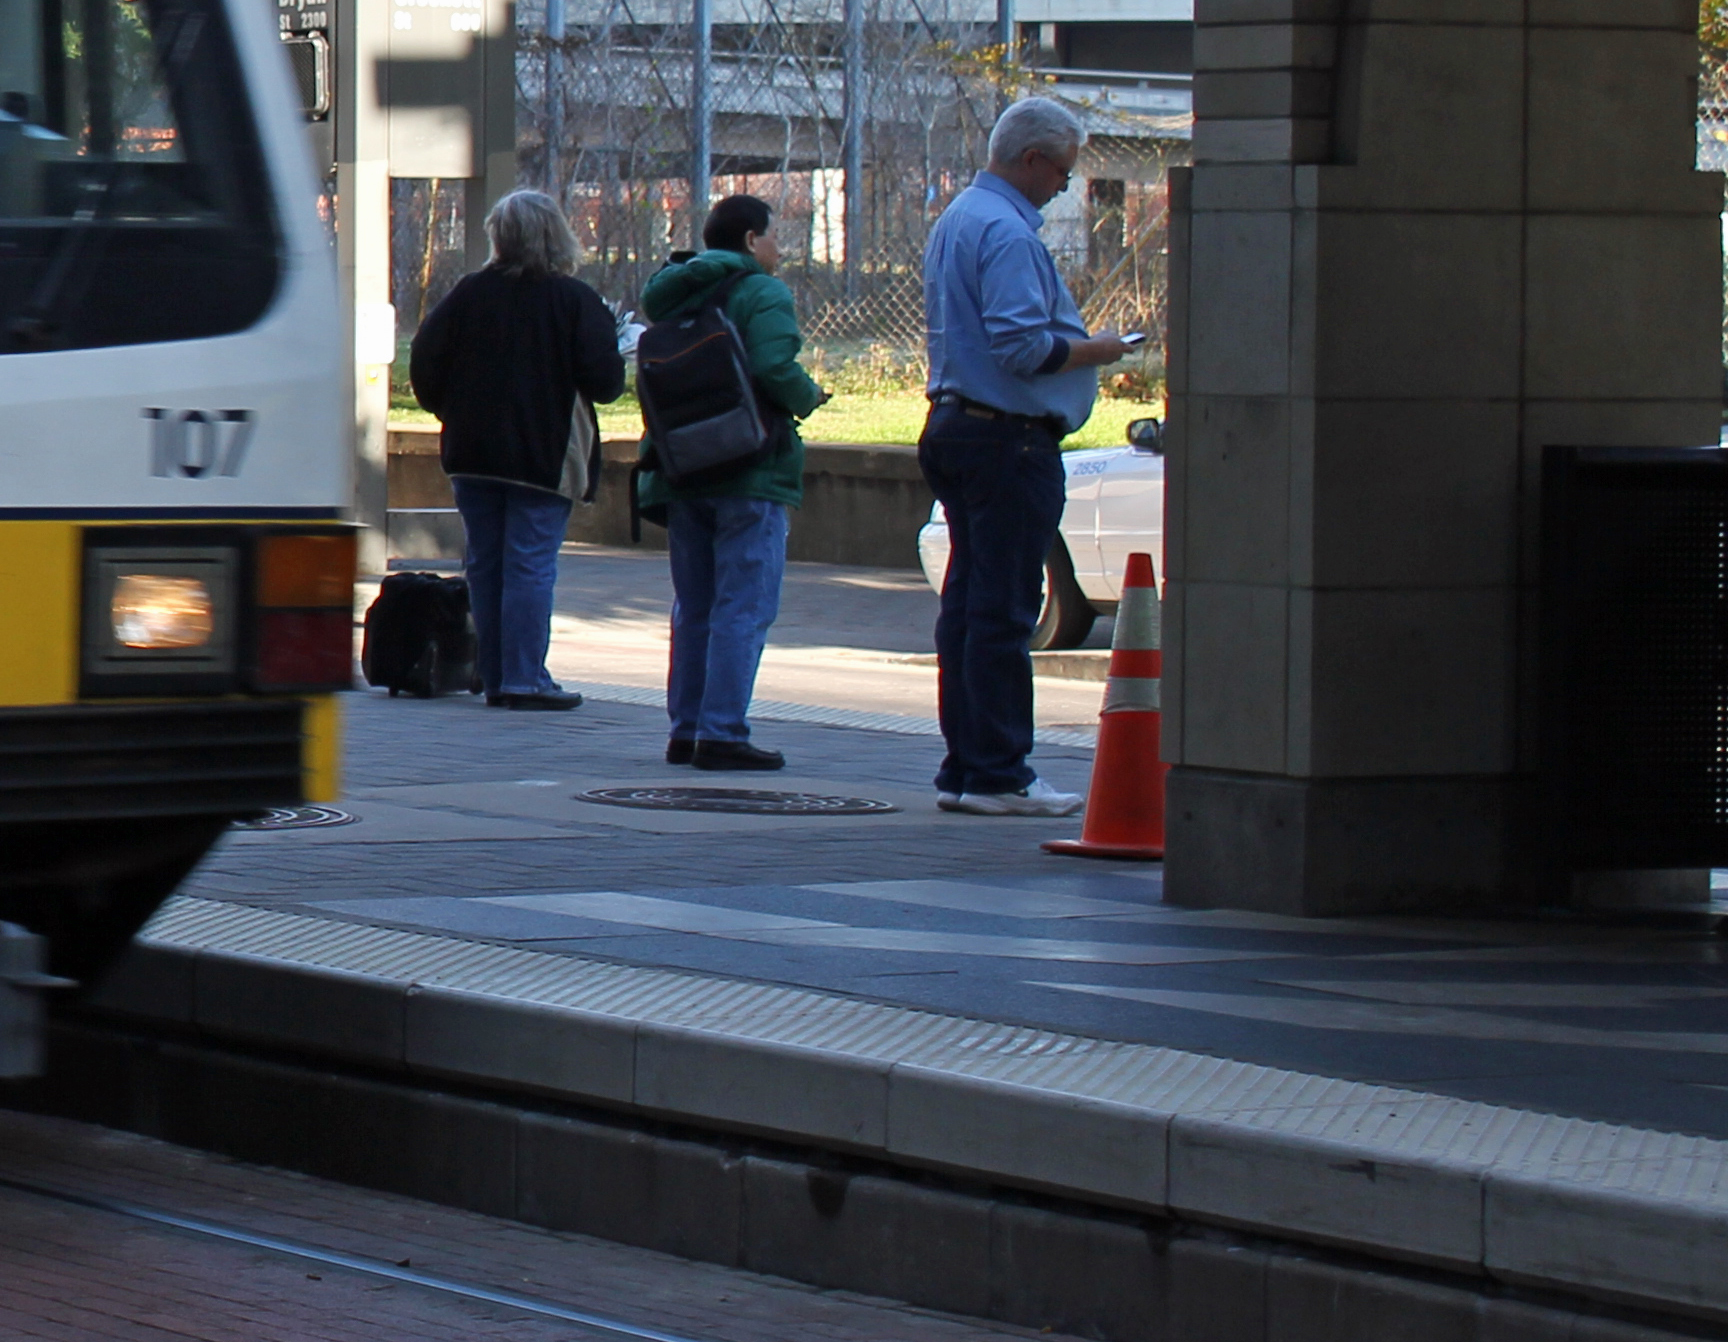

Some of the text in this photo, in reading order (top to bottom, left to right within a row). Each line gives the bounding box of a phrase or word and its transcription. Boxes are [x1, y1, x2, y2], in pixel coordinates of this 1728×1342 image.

[279, 11, 327, 30] St 2300
[139, 407, 258, 479] 107
[1072, 461, 1107, 476] 2850
